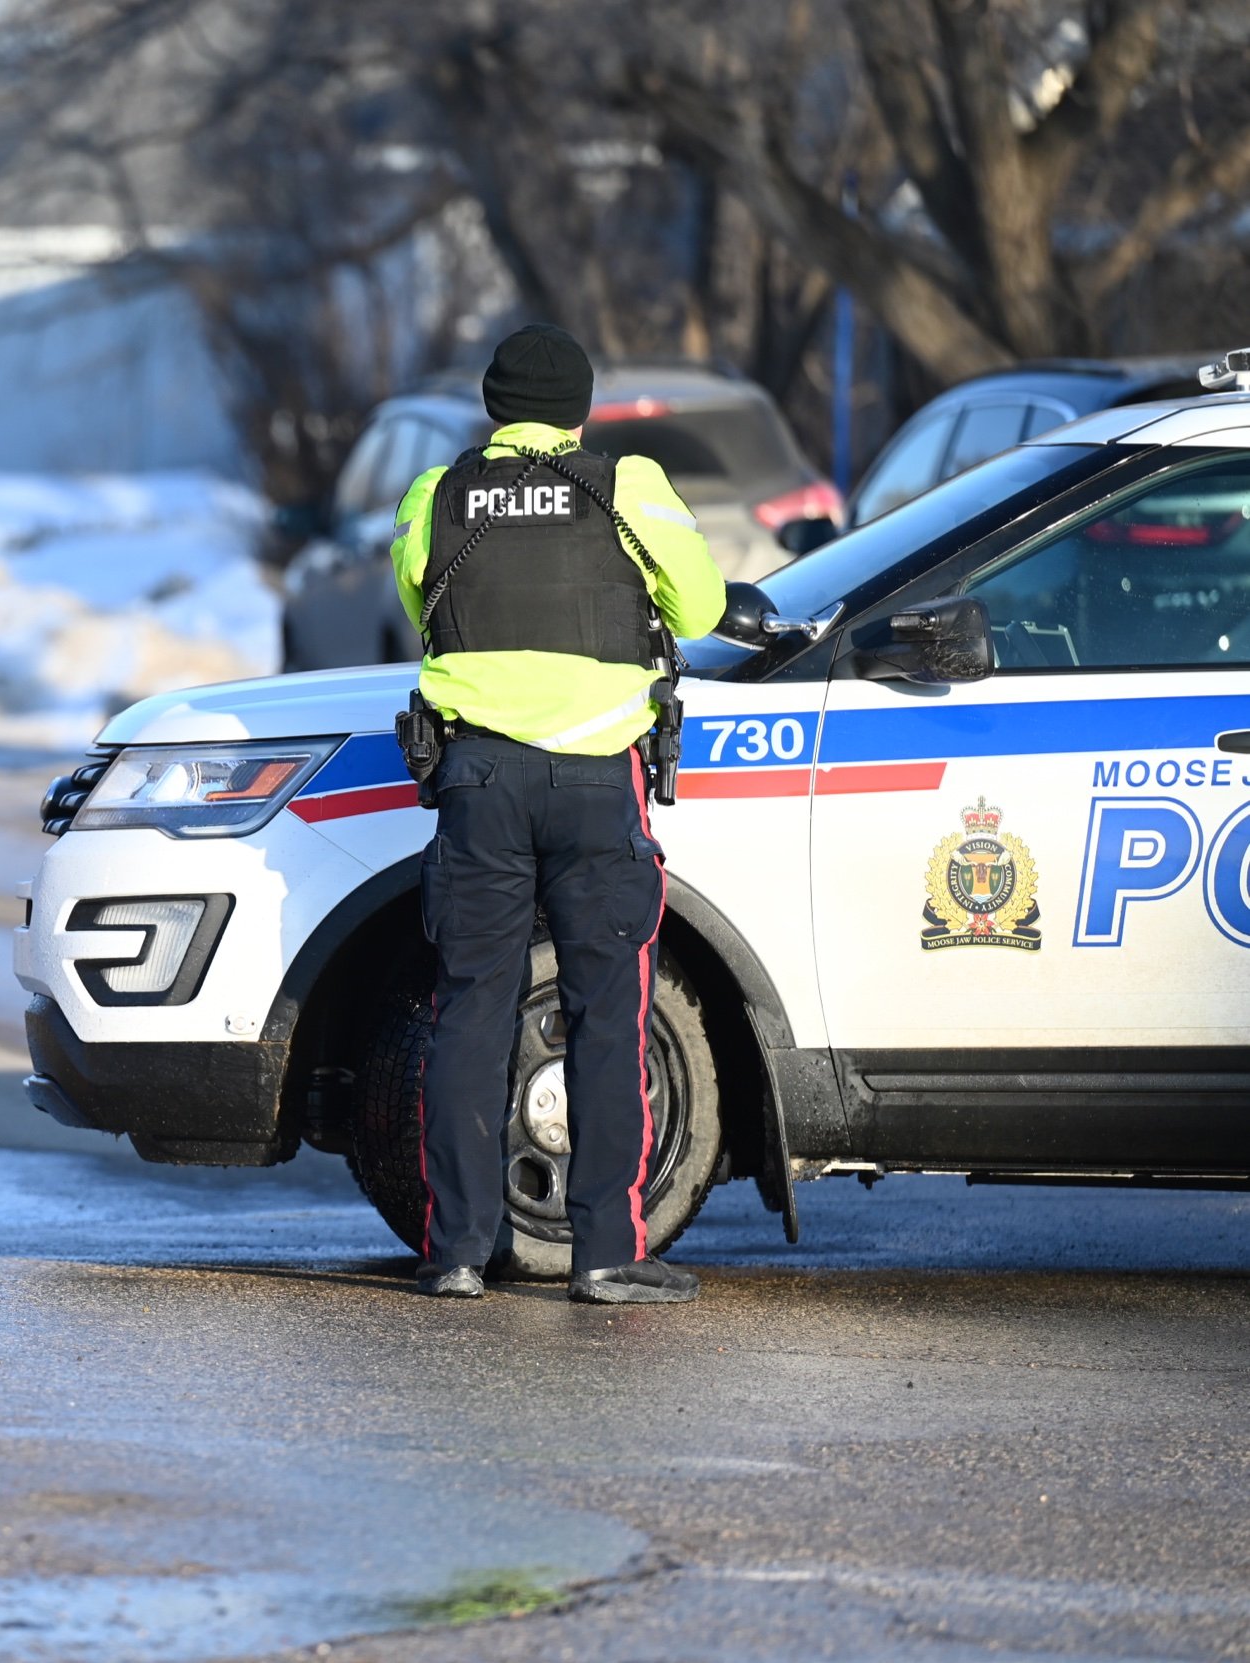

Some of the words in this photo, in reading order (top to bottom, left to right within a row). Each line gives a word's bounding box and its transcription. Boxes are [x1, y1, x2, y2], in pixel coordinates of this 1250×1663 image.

[468, 486, 570, 519] POLICE
[702, 718, 804, 762] 730
[1092, 759, 1233, 787] MOOSE
[965, 841, 998, 852] VISION
[950, 863, 974, 909] INTEGRITY
[981, 864, 1013, 911] COMMUNITY
[927, 937, 955, 949] MOOSE
[956, 936, 971, 946] JAW
[972, 936, 1001, 944] POLICE
[1002, 937, 1034, 949] SERVICE
